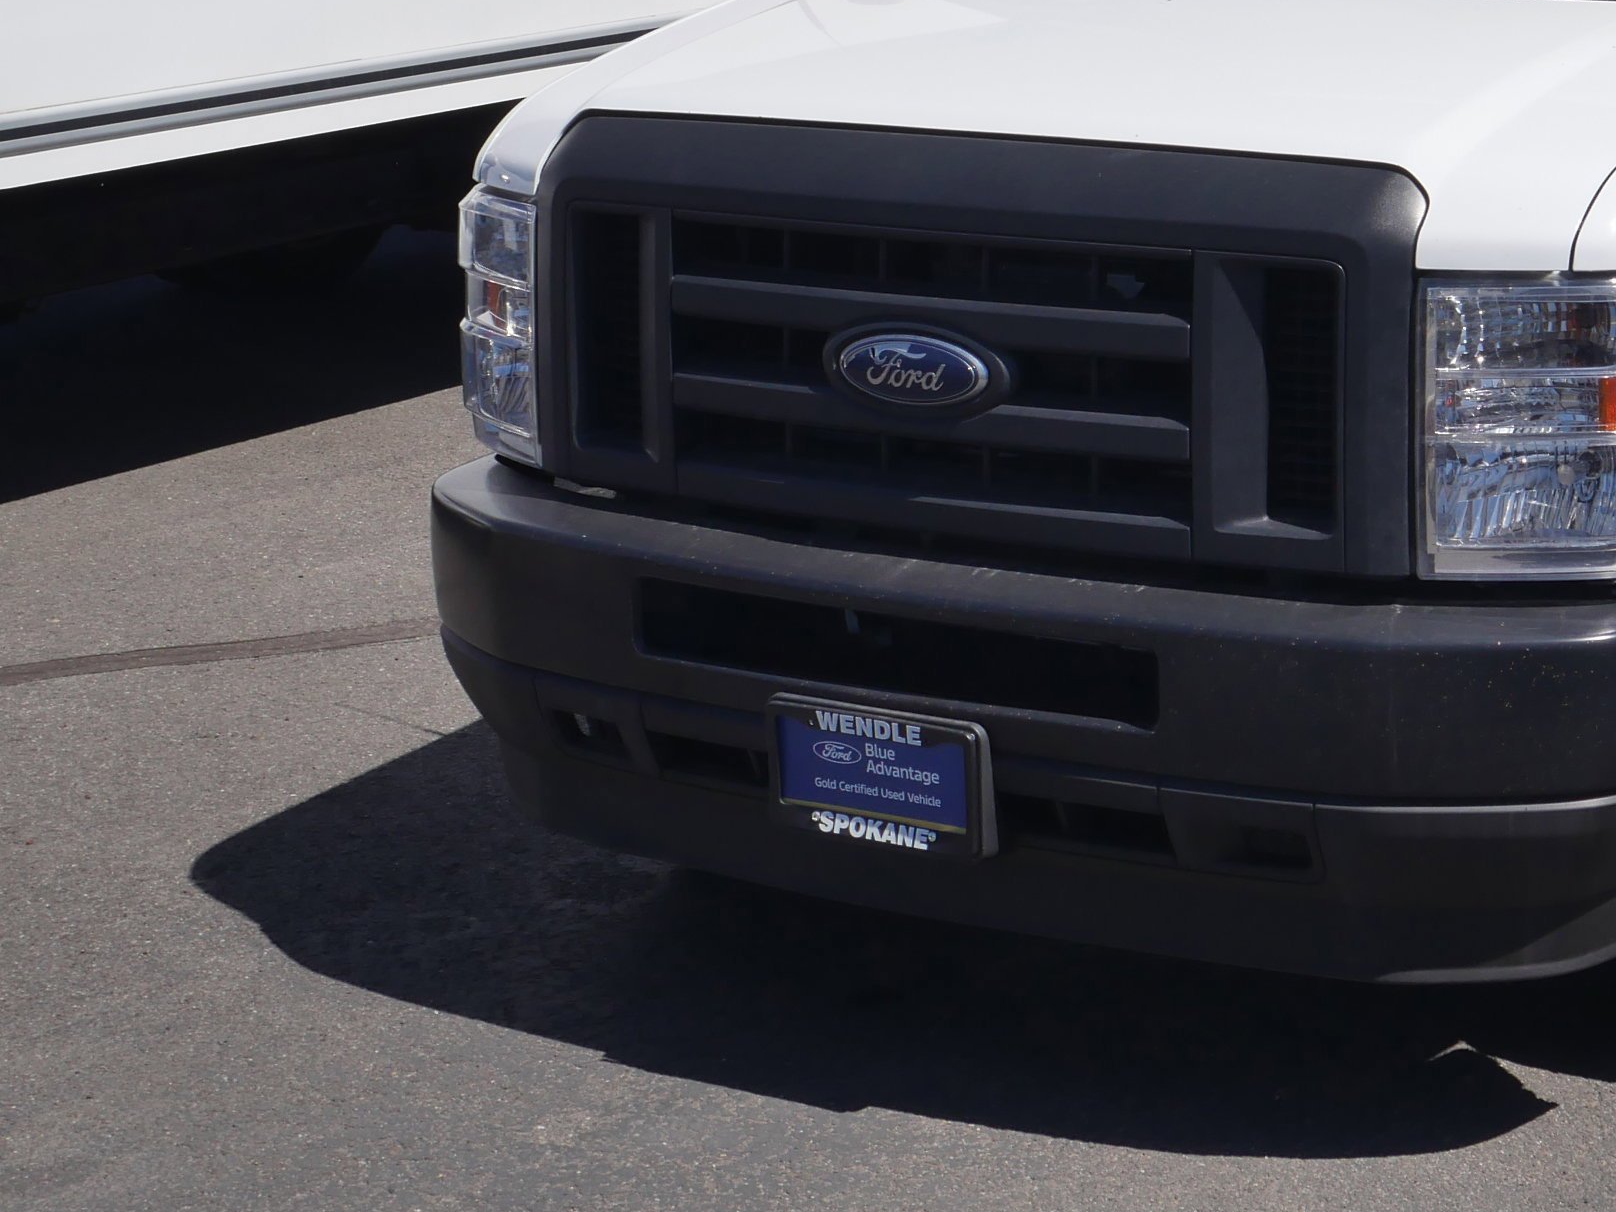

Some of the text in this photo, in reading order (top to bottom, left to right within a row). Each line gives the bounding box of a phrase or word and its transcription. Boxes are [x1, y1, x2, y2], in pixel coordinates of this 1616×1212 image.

[866, 346, 946, 392] Ford
[815, 710, 922, 747] WENDLE
[822, 743, 852, 762] Ford
[865, 742, 896, 761] Blue
[866, 759, 940, 786] Advantage
[814, 776, 942, 808] Gold Certified Used Vehicle
[818, 810, 930, 851] SPOKANE
